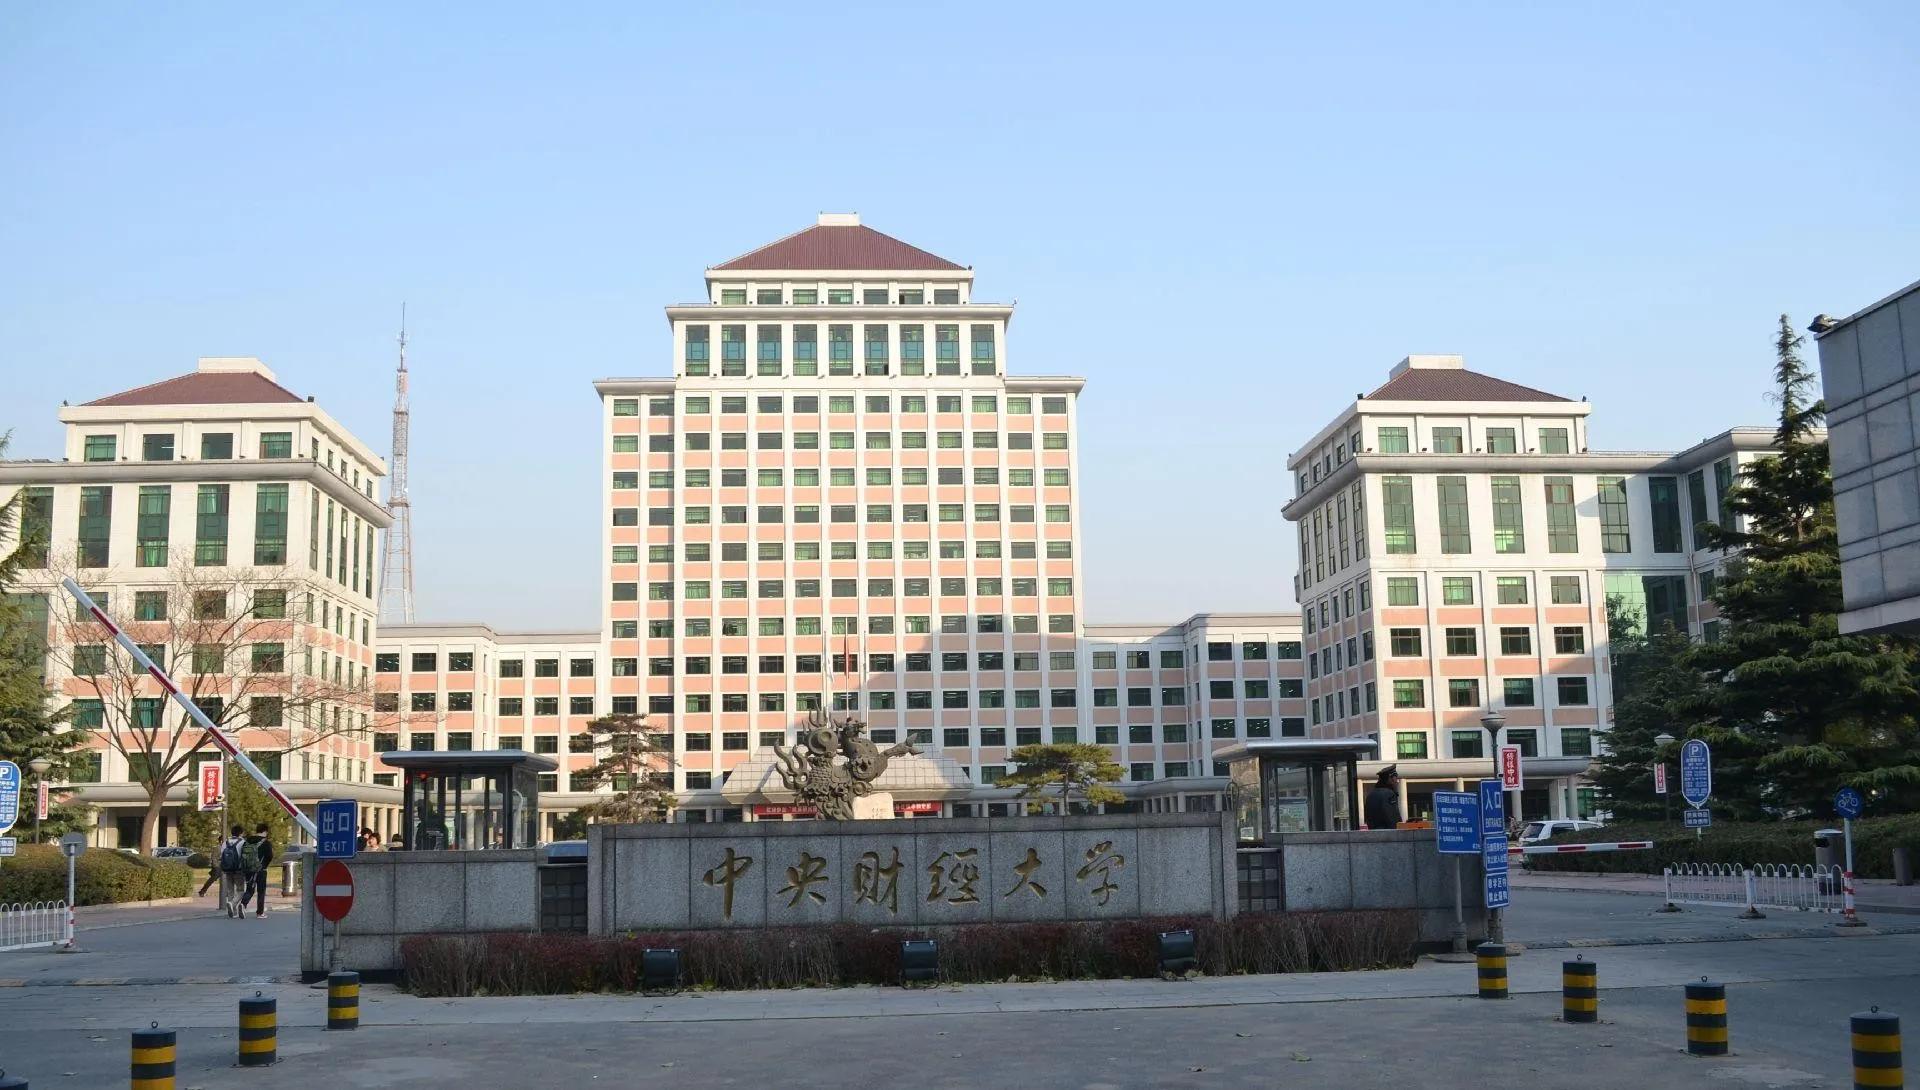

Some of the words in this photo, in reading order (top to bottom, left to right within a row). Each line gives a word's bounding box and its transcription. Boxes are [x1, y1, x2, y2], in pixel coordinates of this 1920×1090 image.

[1485, 788, 1502, 811] 入口
[322, 810, 350, 834] 出口
[324, 840, 348, 852] EXIT
